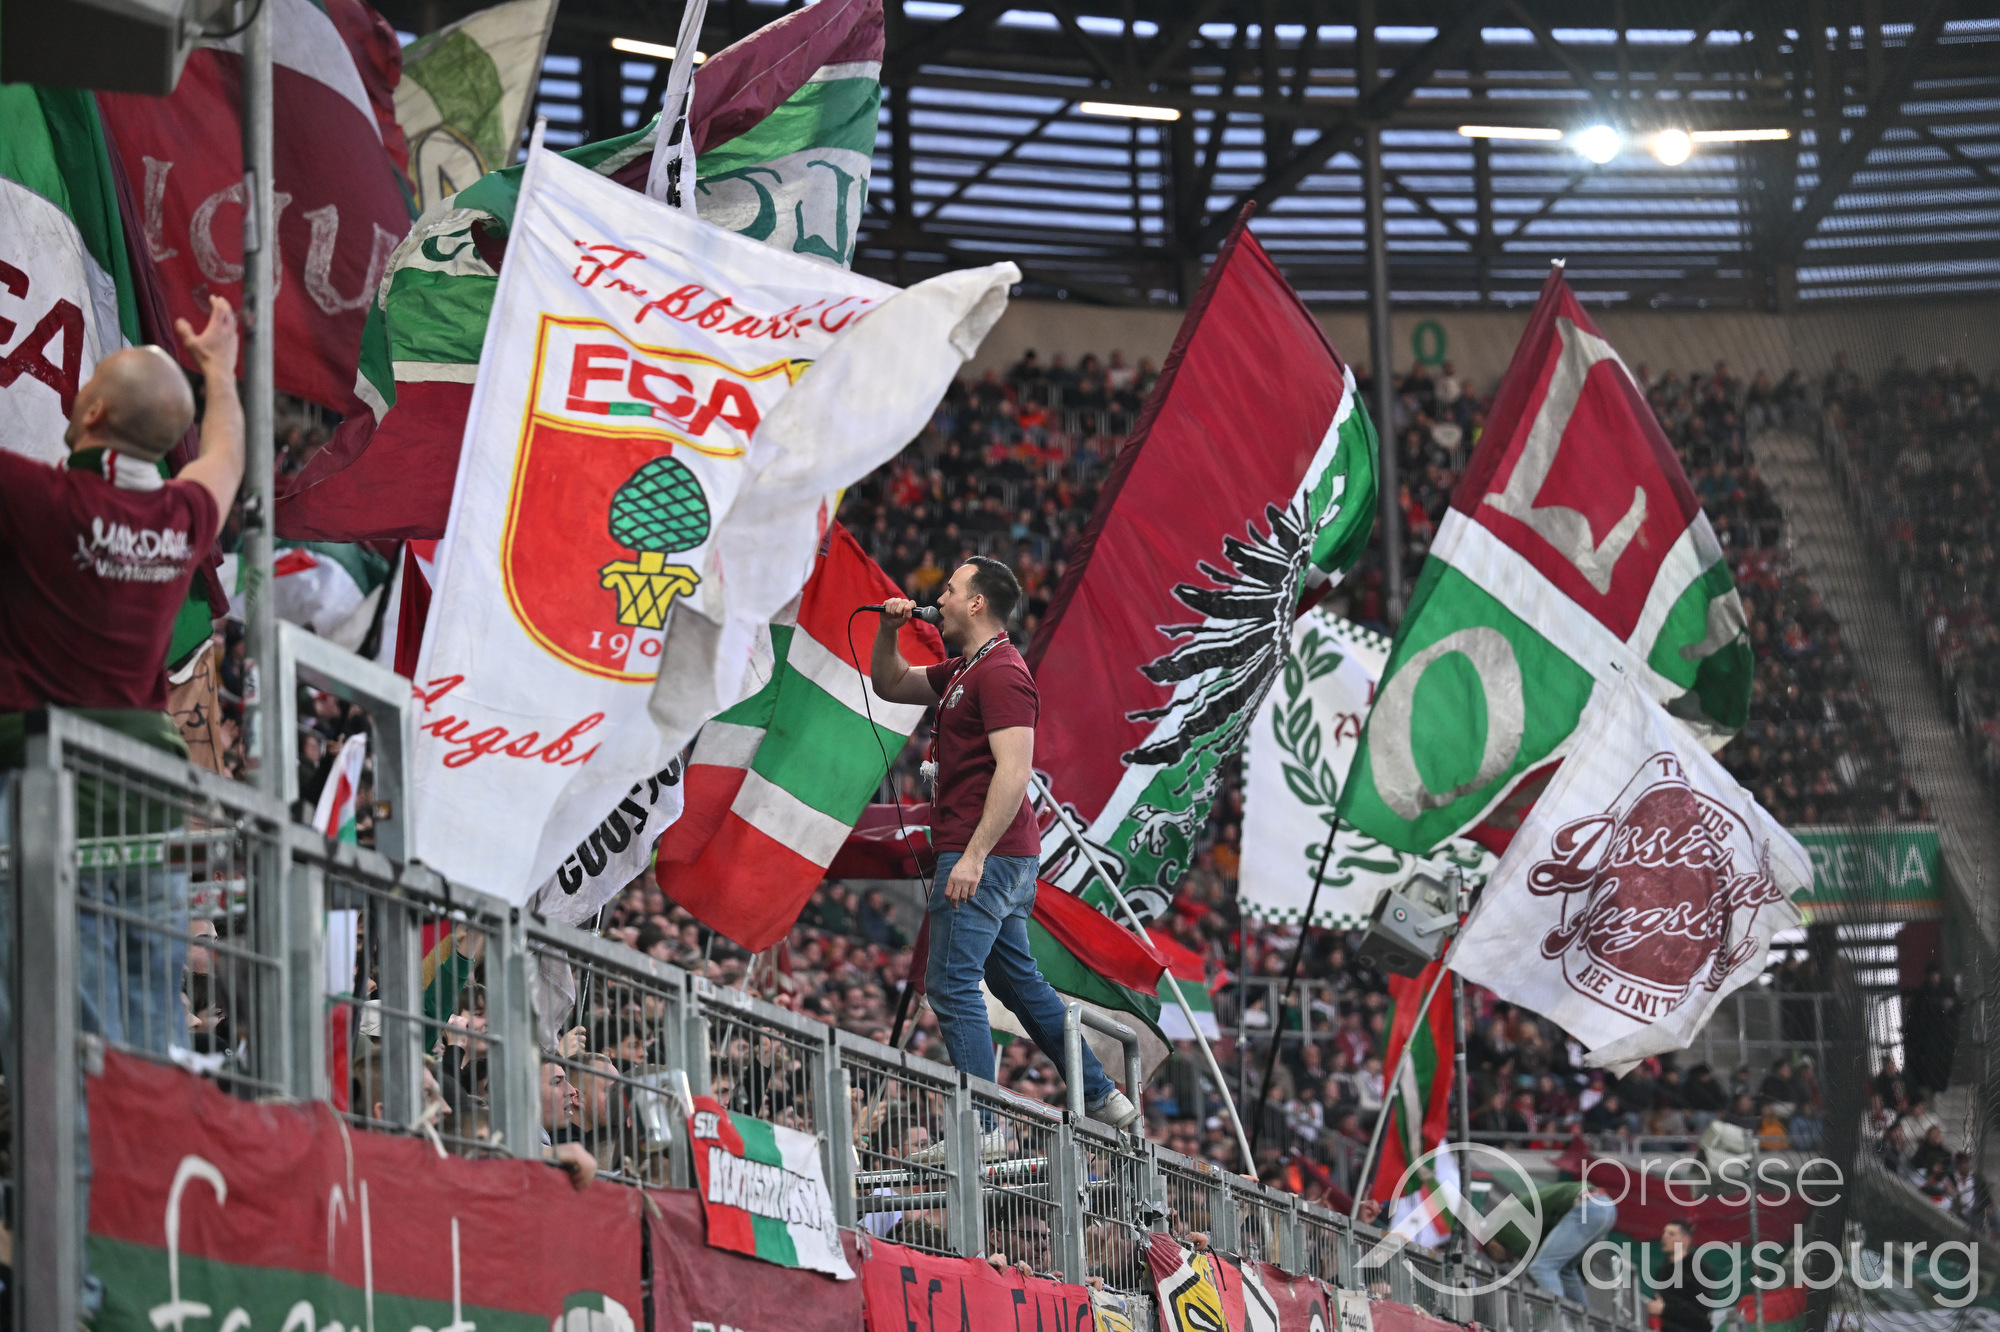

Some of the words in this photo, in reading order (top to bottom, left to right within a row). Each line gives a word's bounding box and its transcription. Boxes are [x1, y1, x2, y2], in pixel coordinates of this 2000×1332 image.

[565, 342, 762, 441] FCA
[588, 630, 663, 660] 190
[411, 673, 606, 769] Augsb
[1656, 757, 1688, 781] TH
[1803, 844, 1933, 890] RENA
[1575, 963, 1614, 995] ARE
[1613, 983, 1679, 1018] UNIT
